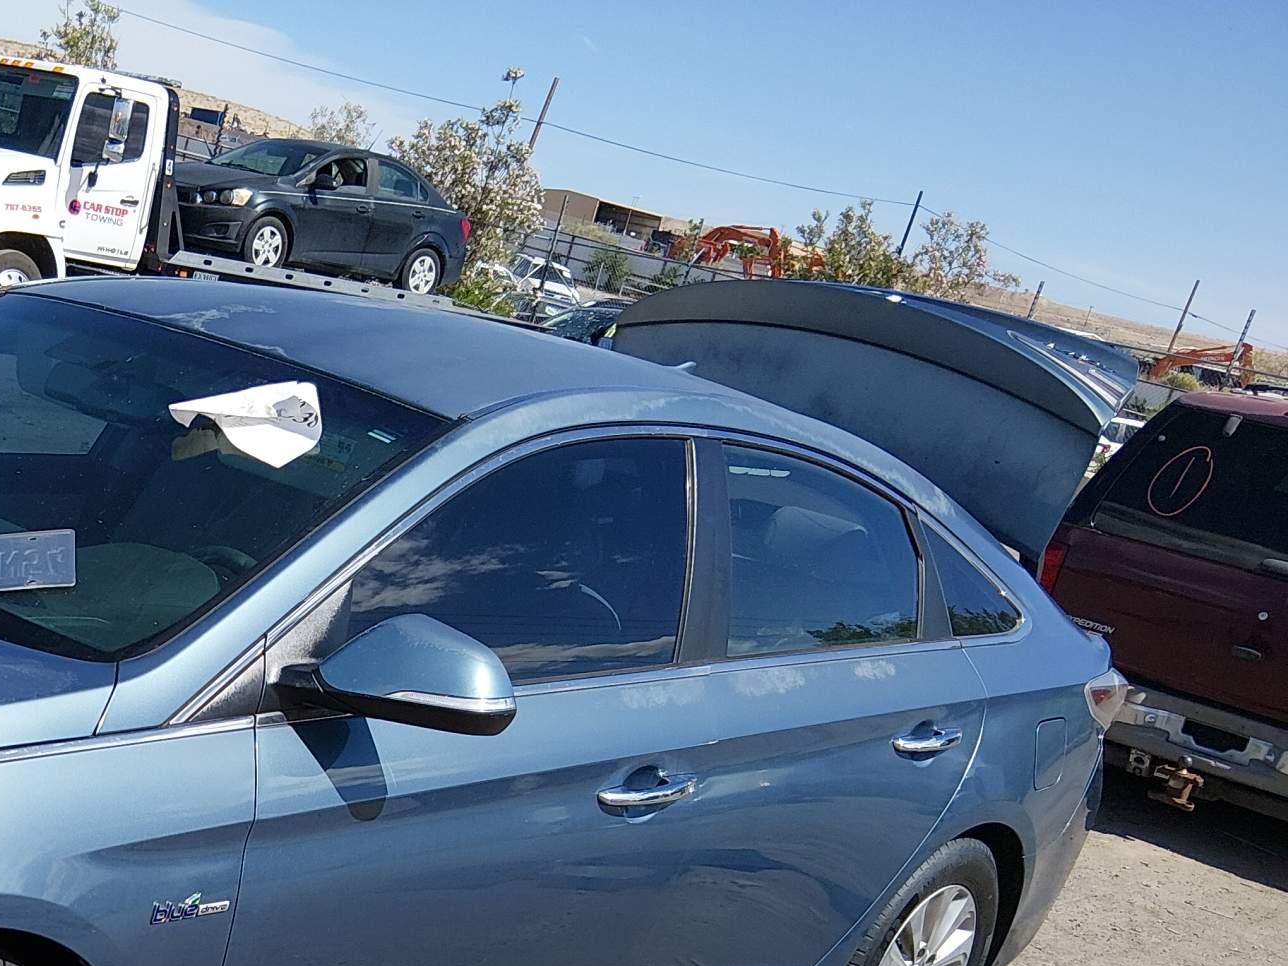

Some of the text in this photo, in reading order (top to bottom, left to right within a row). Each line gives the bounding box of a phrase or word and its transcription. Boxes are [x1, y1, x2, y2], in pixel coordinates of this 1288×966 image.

[83, 200, 128, 218] CAR STOP
[85, 212, 124, 226] TOWING
[150, 901, 200, 925] blue
